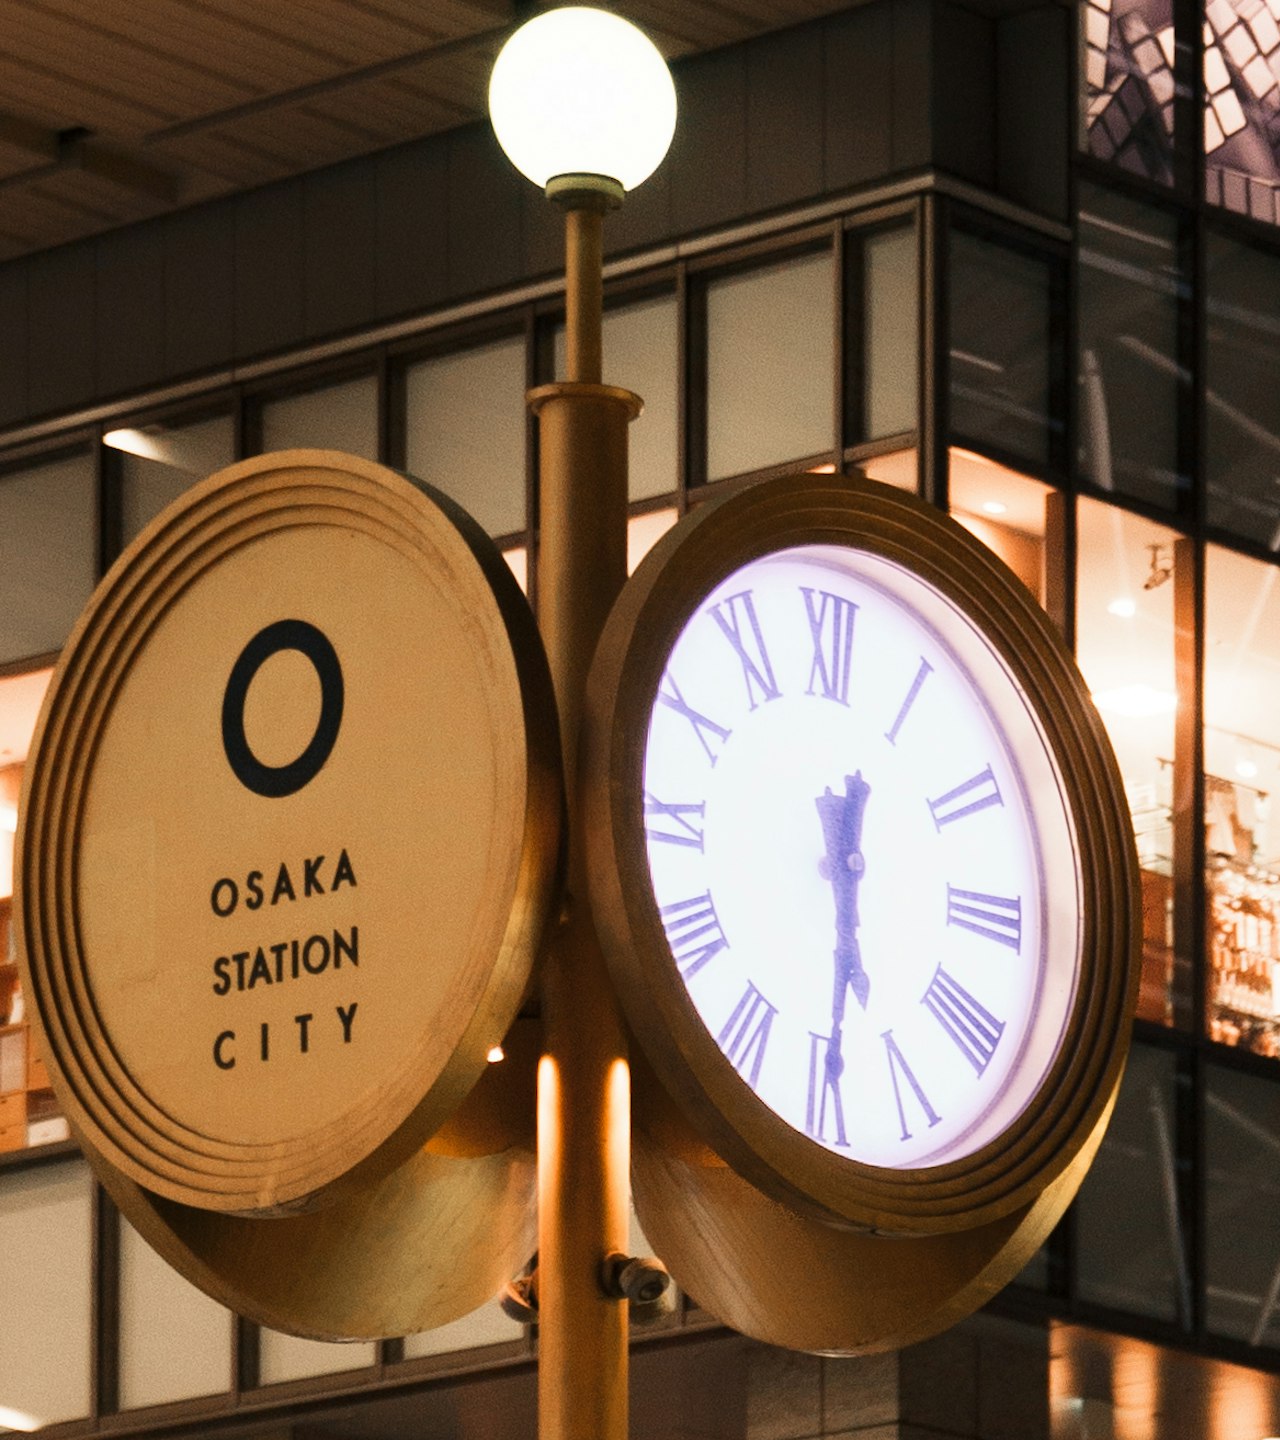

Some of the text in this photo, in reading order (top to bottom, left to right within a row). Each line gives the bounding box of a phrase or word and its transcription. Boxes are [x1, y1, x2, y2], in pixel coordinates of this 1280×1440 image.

[210, 848, 358, 918] OSAKA
[212, 925, 359, 997] STATION
[212, 1002, 358, 1071] CITY
